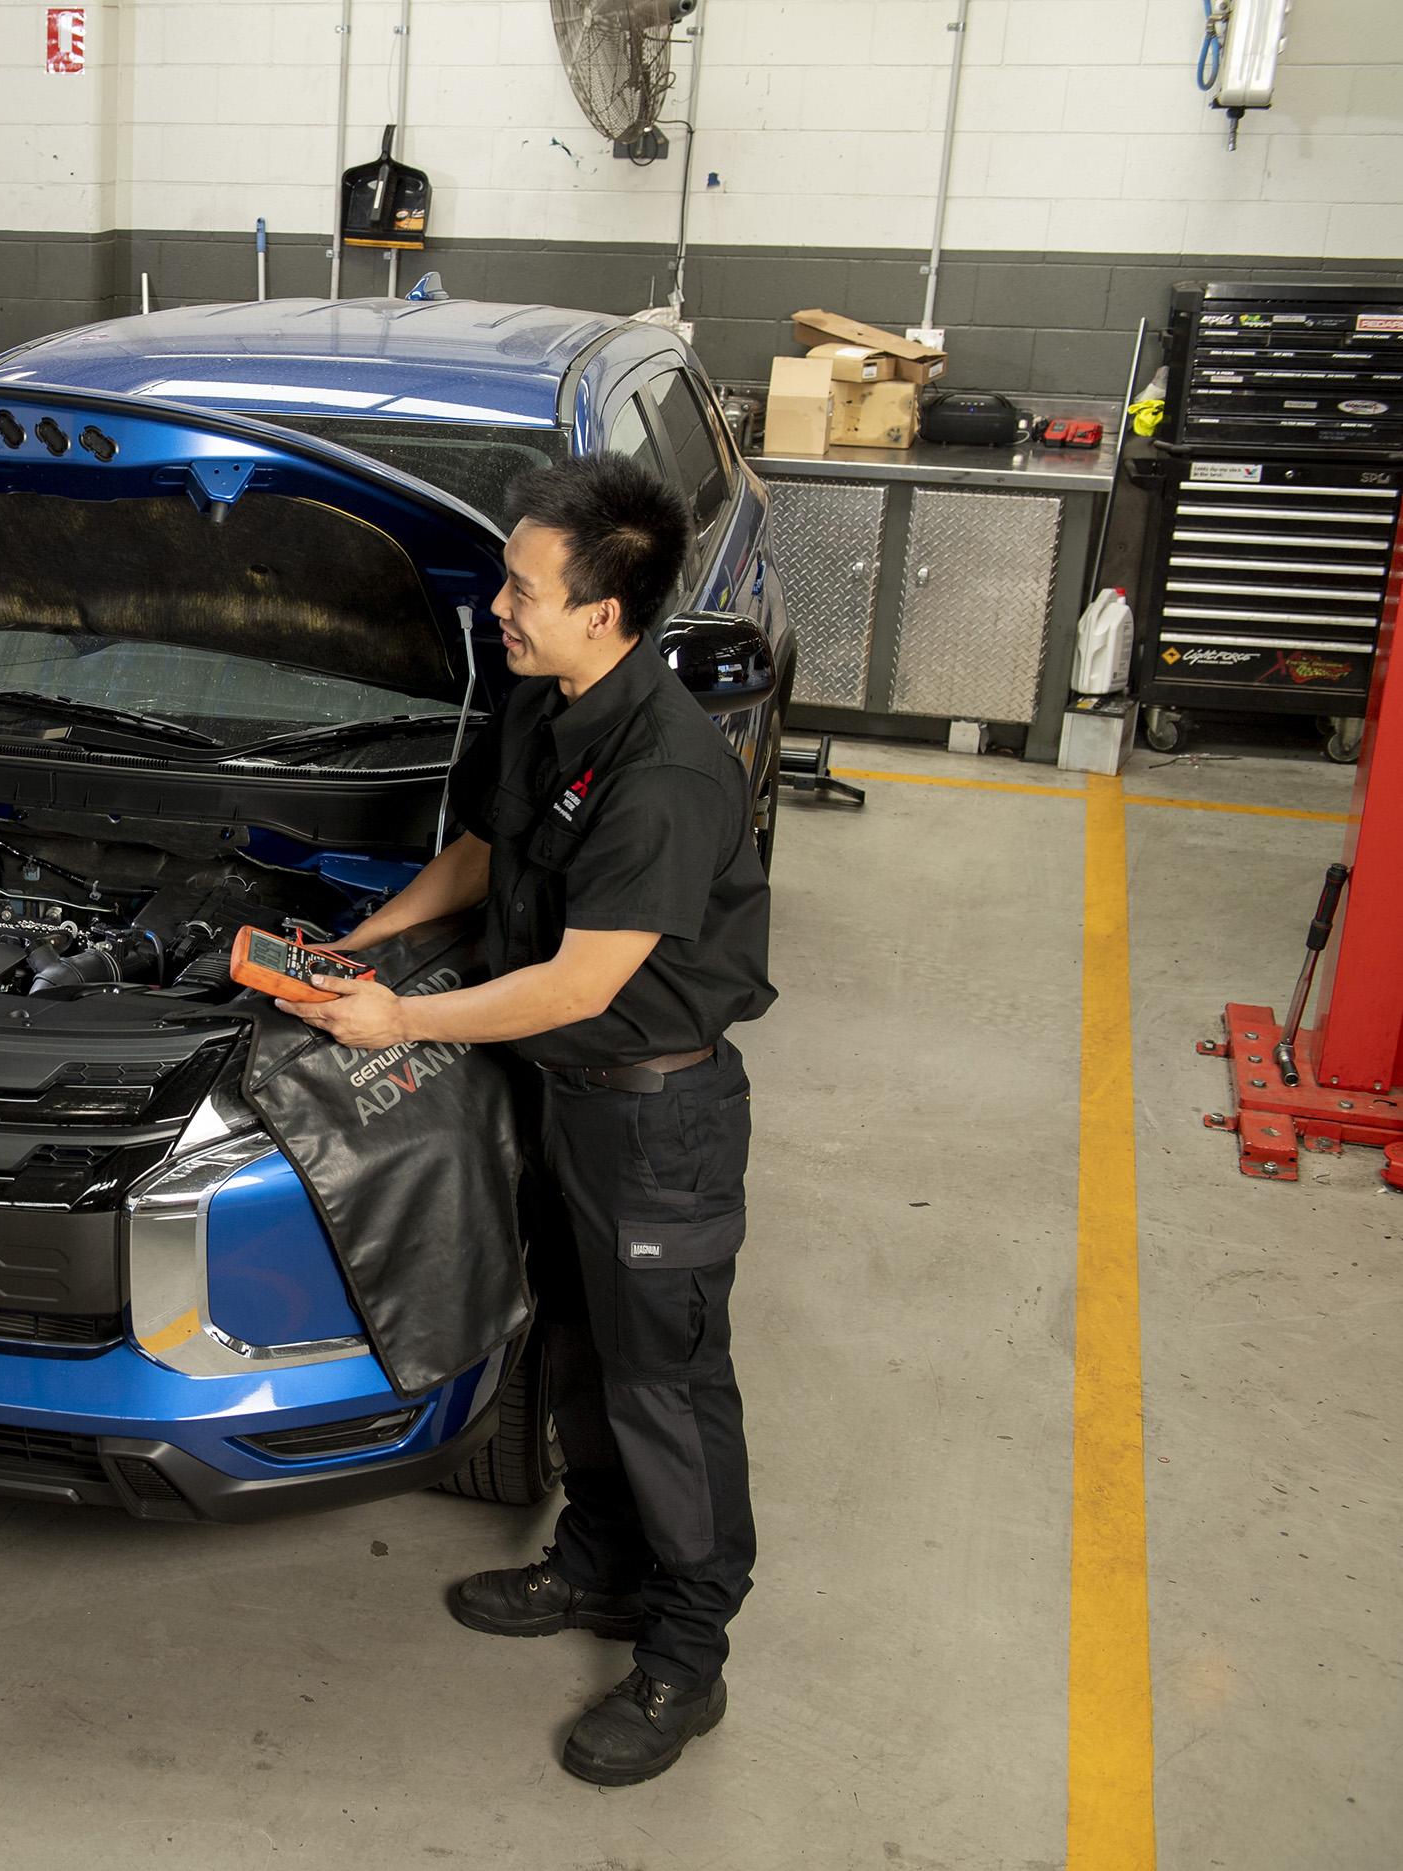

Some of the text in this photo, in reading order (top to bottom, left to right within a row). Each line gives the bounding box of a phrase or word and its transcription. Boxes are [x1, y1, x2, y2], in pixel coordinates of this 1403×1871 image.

[1360, 320, 1403, 330] REDAR
[355, 1042, 472, 1127] ADVAN
[633, 1244, 660, 1256] MAGNUM
